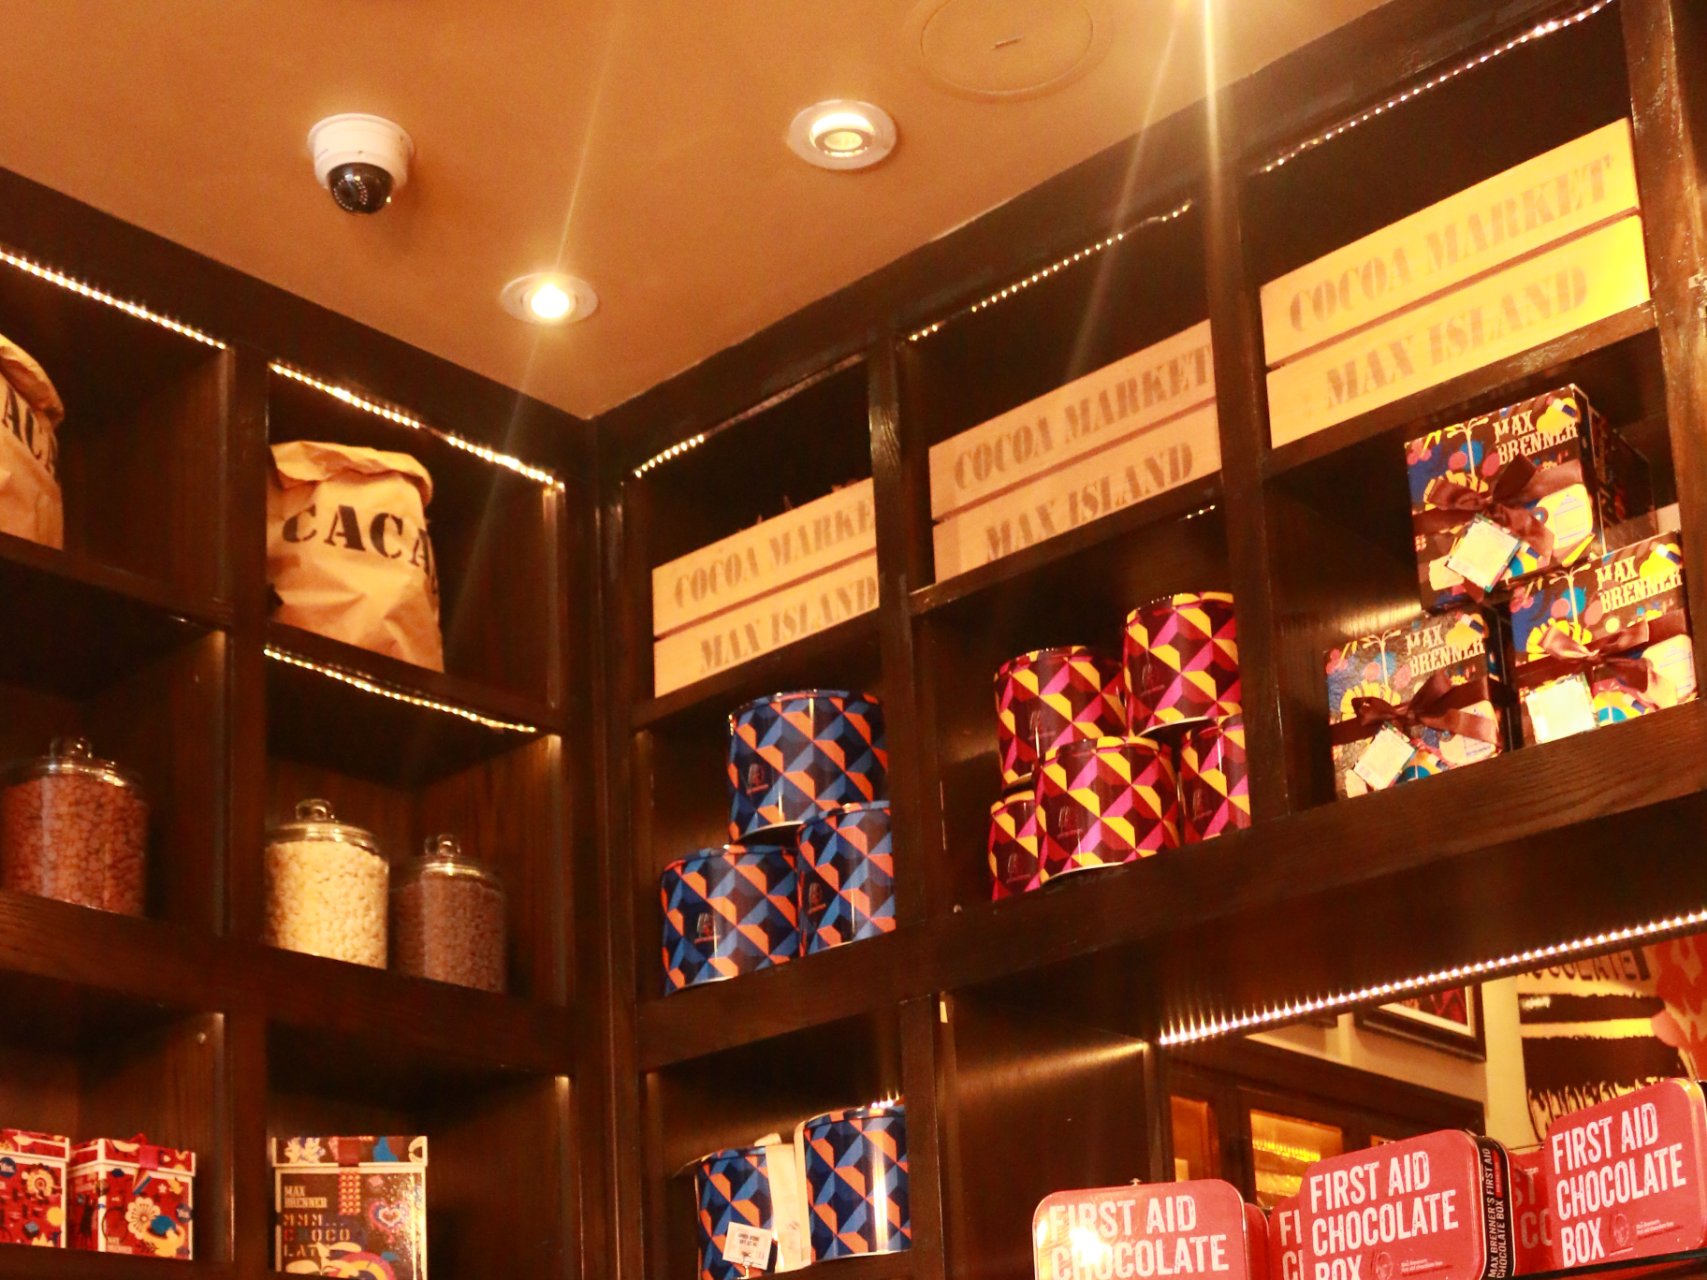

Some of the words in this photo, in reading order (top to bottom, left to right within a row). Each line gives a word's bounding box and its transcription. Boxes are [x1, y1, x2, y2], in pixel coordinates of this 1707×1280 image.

[1290, 248, 1415, 332] COCOA
[1424, 154, 1614, 274] MARKET
[1323, 334, 1418, 409] MAX
[1428, 264, 1587, 366] ISLAND
[954, 416, 1054, 490] COCOA
[1063, 345, 1211, 439] MARKET
[1493, 409, 1535, 443] MAX
[1497, 420, 1579, 466] BRENNER
[984, 503, 1060, 561] MAX
[1066, 441, 1193, 527] ISLAND
[675, 544, 760, 608] COCOA
[769, 503, 875, 572] MARKE
[1595, 556, 1639, 590] MAX
[1600, 567, 1684, 614] BRENNER
[700, 617, 768, 674] MAX
[773, 573, 878, 643] ISLAND
[1405, 625, 1445, 655] MAX
[1410, 636, 1486, 677] BRENNER
[1482, 1148, 1492, 1165] AID
[1552, 1116, 1613, 1174] FIRST
[1621, 1103, 1658, 1153] AID
[1310, 1161, 1380, 1213] FIRST
[1388, 1151, 1430, 1196] AID
[1484, 1167, 1495, 1196] FIRST
[1557, 1143, 1686, 1220] CHOCOLATE
[1048, 1199, 1136, 1242] FIRST
[1146, 1195, 1197, 1234] AID
[1312, 1189, 1459, 1257] CHOCOLATE
[1496, 1200, 1504, 1219] BOX
[1488, 1256, 1498, 1278] MAX
[1496, 1222, 1507, 1279] CHOCOLATE
[1561, 1218, 1605, 1267] BOX
